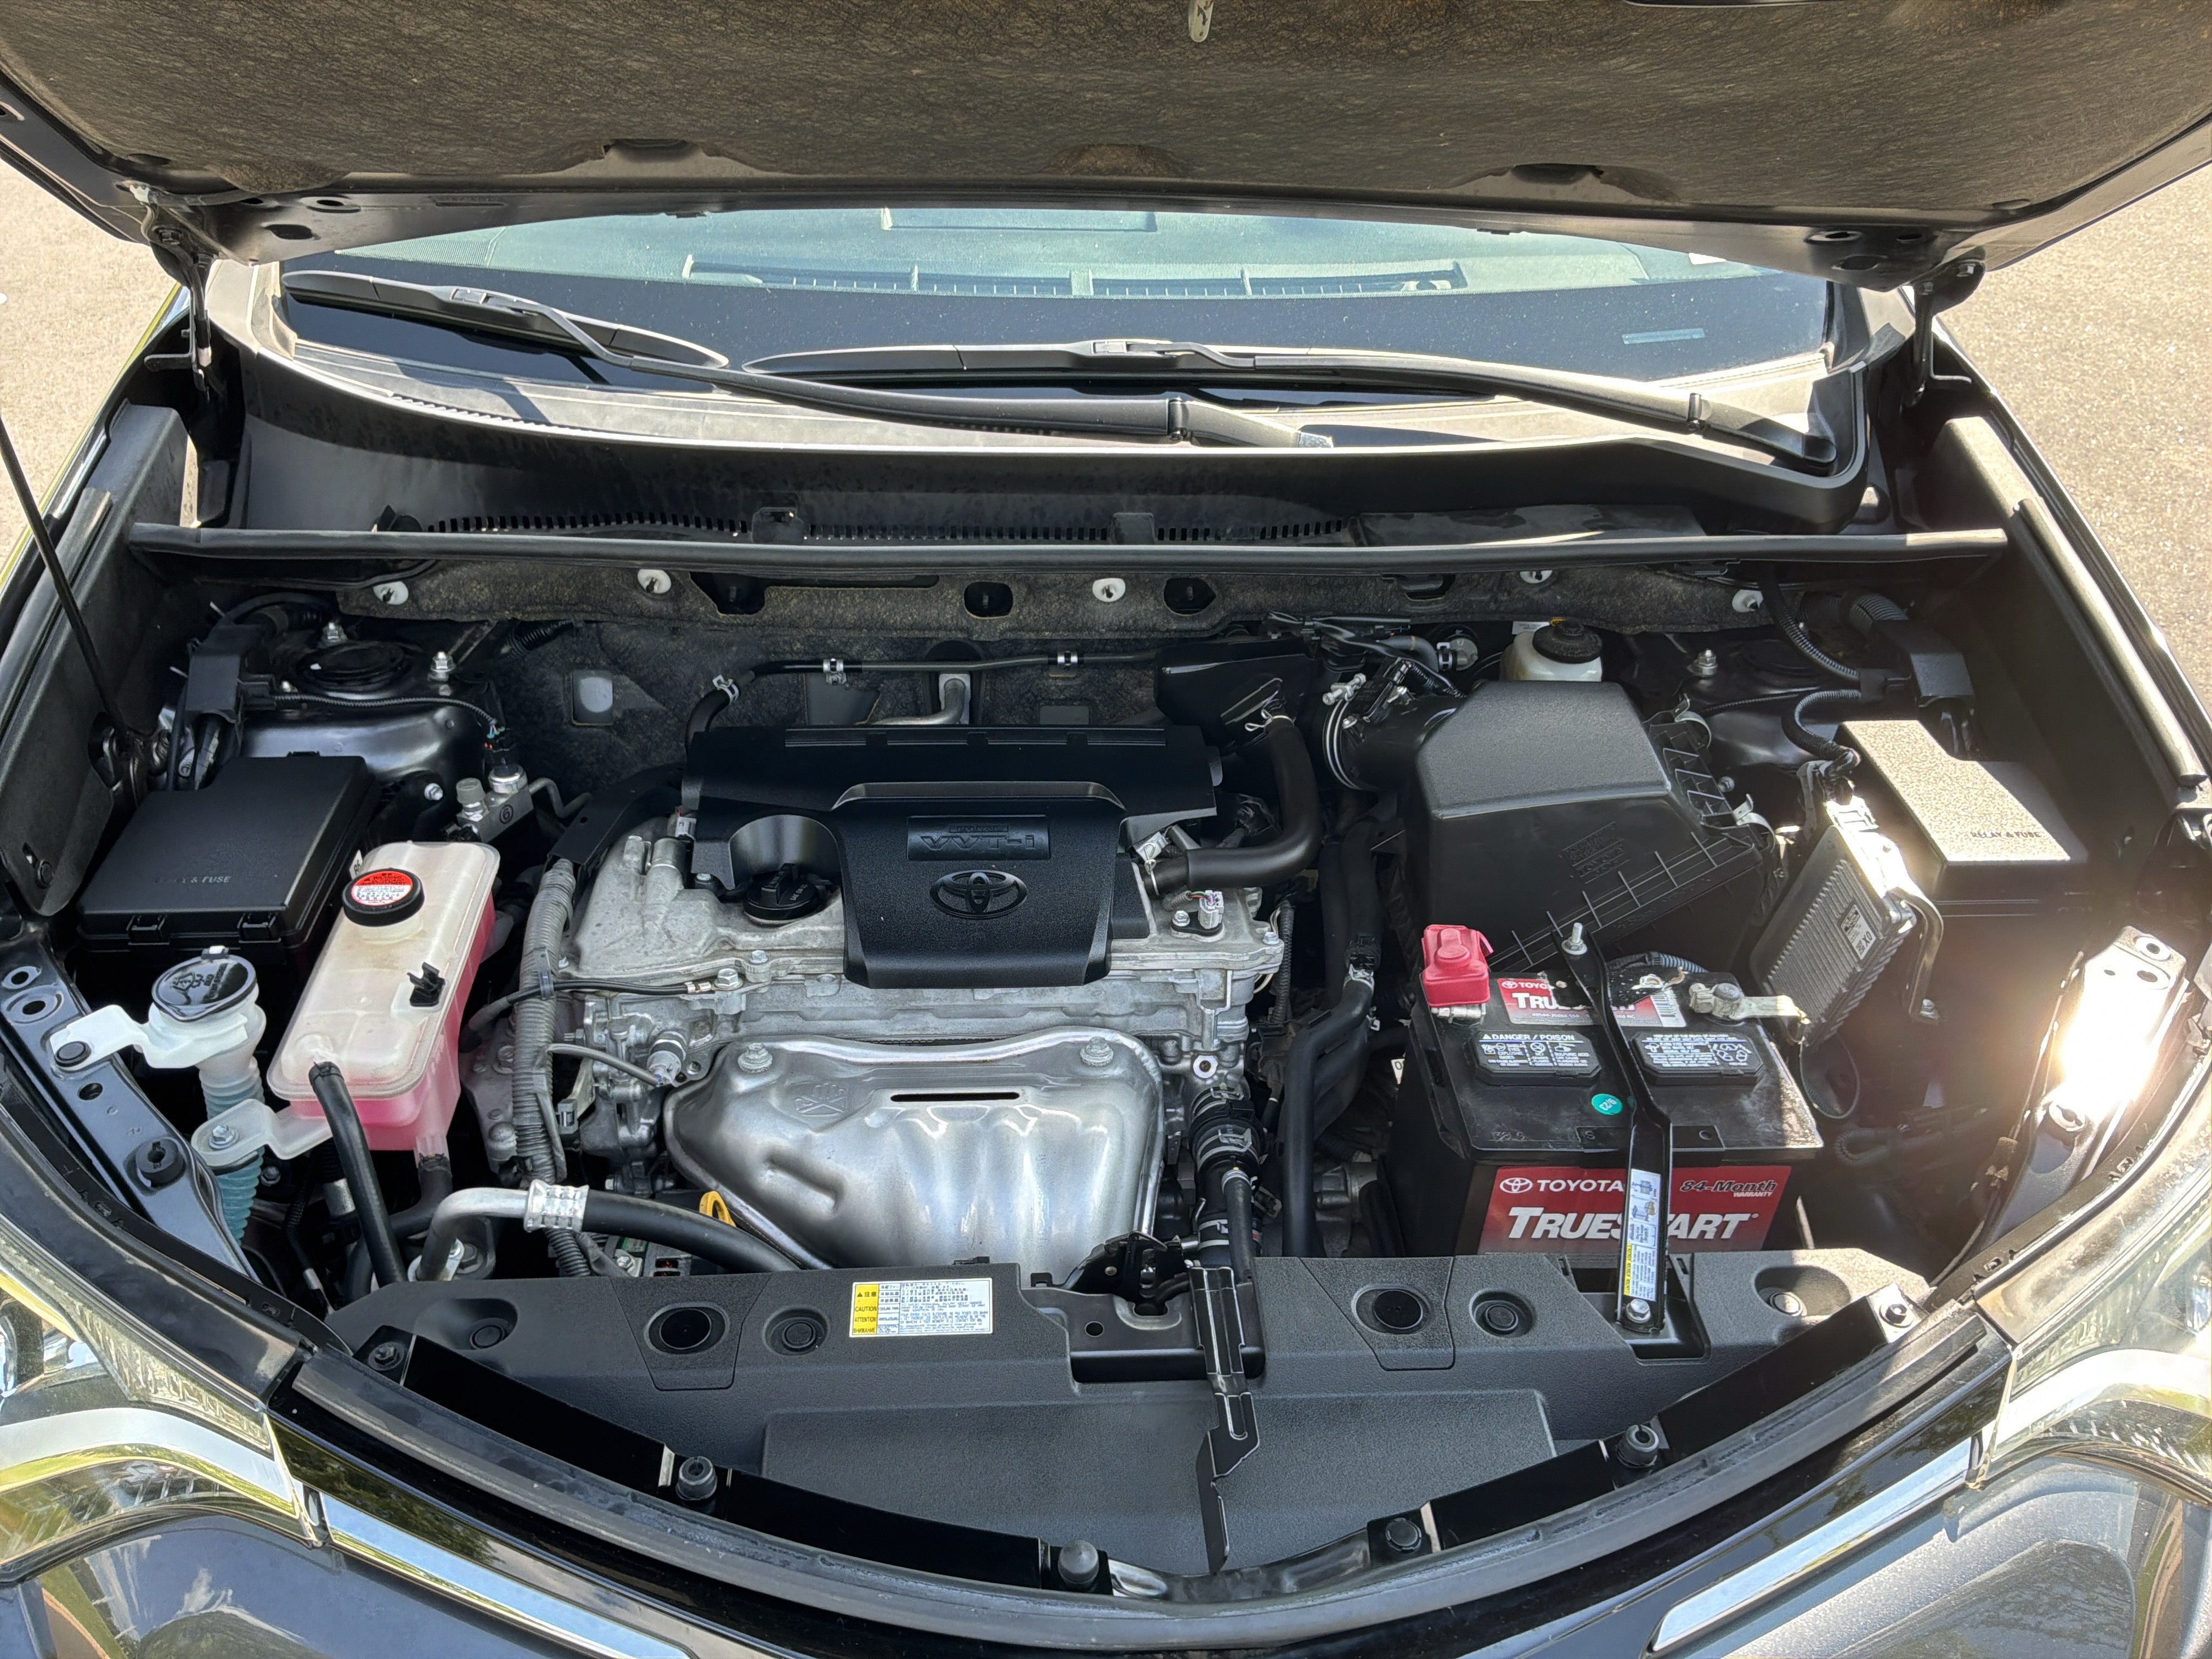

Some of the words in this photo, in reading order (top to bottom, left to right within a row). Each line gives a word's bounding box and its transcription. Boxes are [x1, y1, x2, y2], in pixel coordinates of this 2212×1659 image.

[920, 834, 1035, 850] VVT-i
[1537, 1180, 1624, 1192] TOYOTA
[1679, 1180, 1778, 1193] 84-Month
[1509, 1207, 1751, 1239] TRUEART
